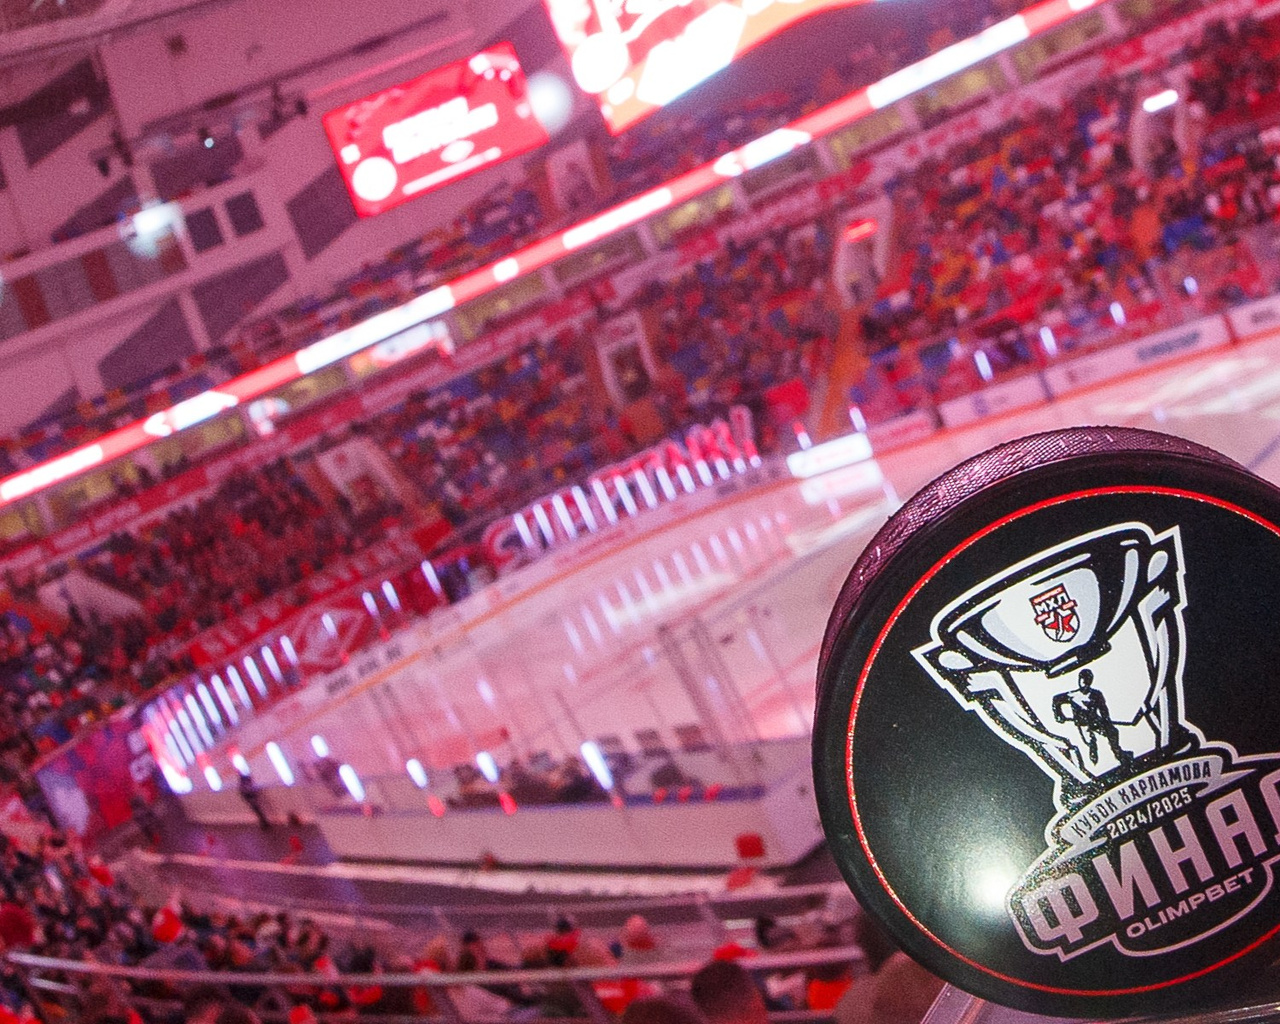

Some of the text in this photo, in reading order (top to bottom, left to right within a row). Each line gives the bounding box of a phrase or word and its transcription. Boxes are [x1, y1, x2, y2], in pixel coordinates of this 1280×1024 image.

[1035, 592, 1069, 615] МХЛ
[1071, 761, 1211, 838] КУБОК ХАРЛАМОВА
[1106, 787, 1192, 839] 2024/2025
[1126, 868, 1254, 939] OLIMPBET
